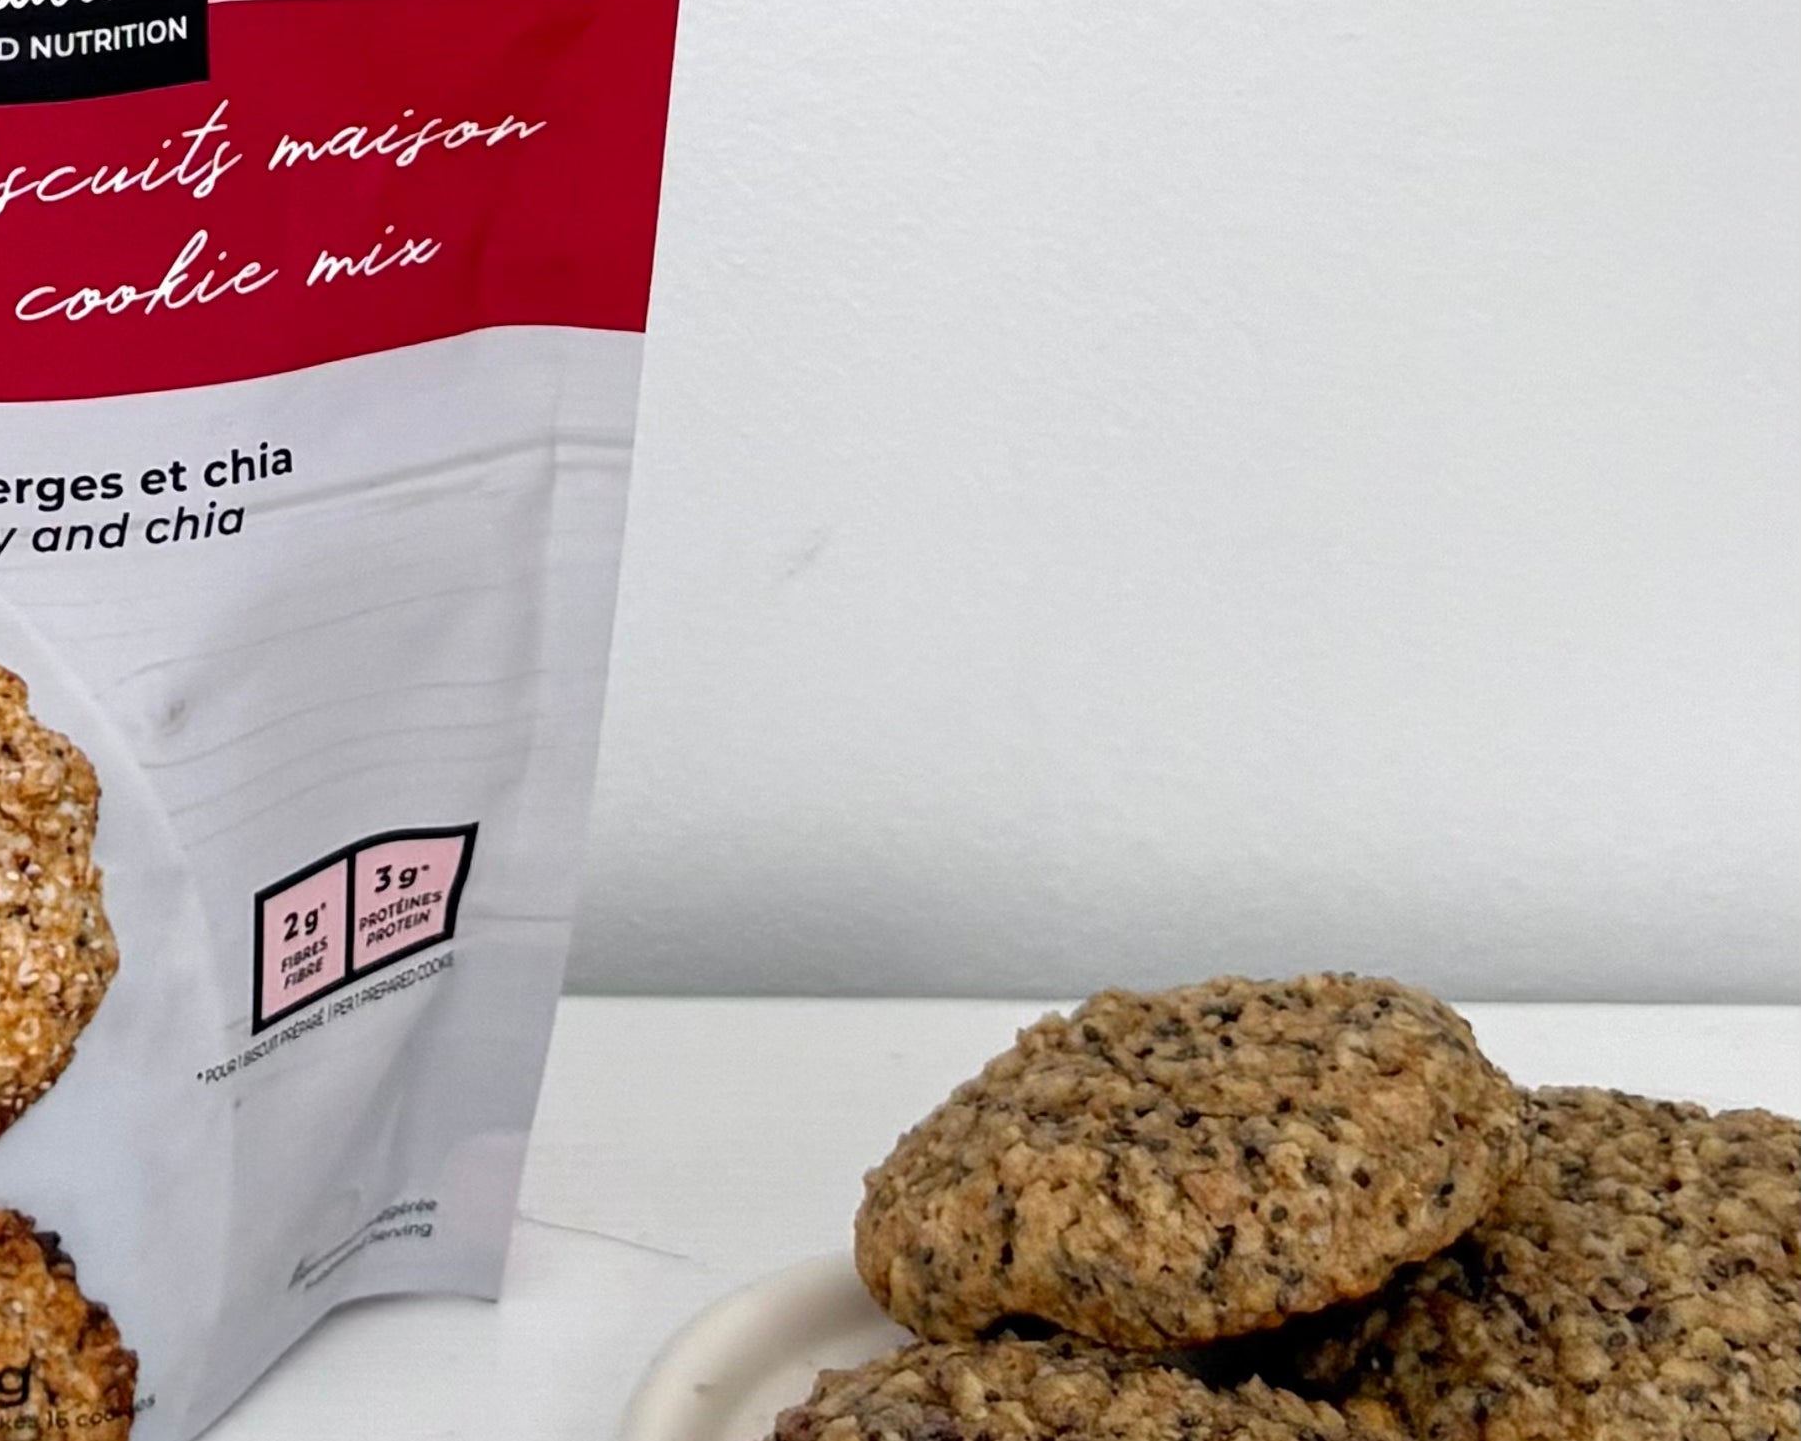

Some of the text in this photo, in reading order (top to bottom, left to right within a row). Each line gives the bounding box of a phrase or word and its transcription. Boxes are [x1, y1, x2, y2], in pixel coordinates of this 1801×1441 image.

[30, 15, 188, 59] NUTRITION
[267, 109, 547, 171] maison
[14, 229, 278, 322] cookie
[306, 225, 442, 286] mix
[140, 461, 188, 496] et
[203, 441, 293, 488] chia
[31, 511, 130, 553] and
[145, 501, 245, 545] chia
[359, 890, 443, 932] PROTÉINES
[366, 909, 432, 948] PROTEIN
[280, 936, 329, 974] FIBRES
[283, 956, 325, 991] FIBRE
[48, 1411, 68, 1430] 16
